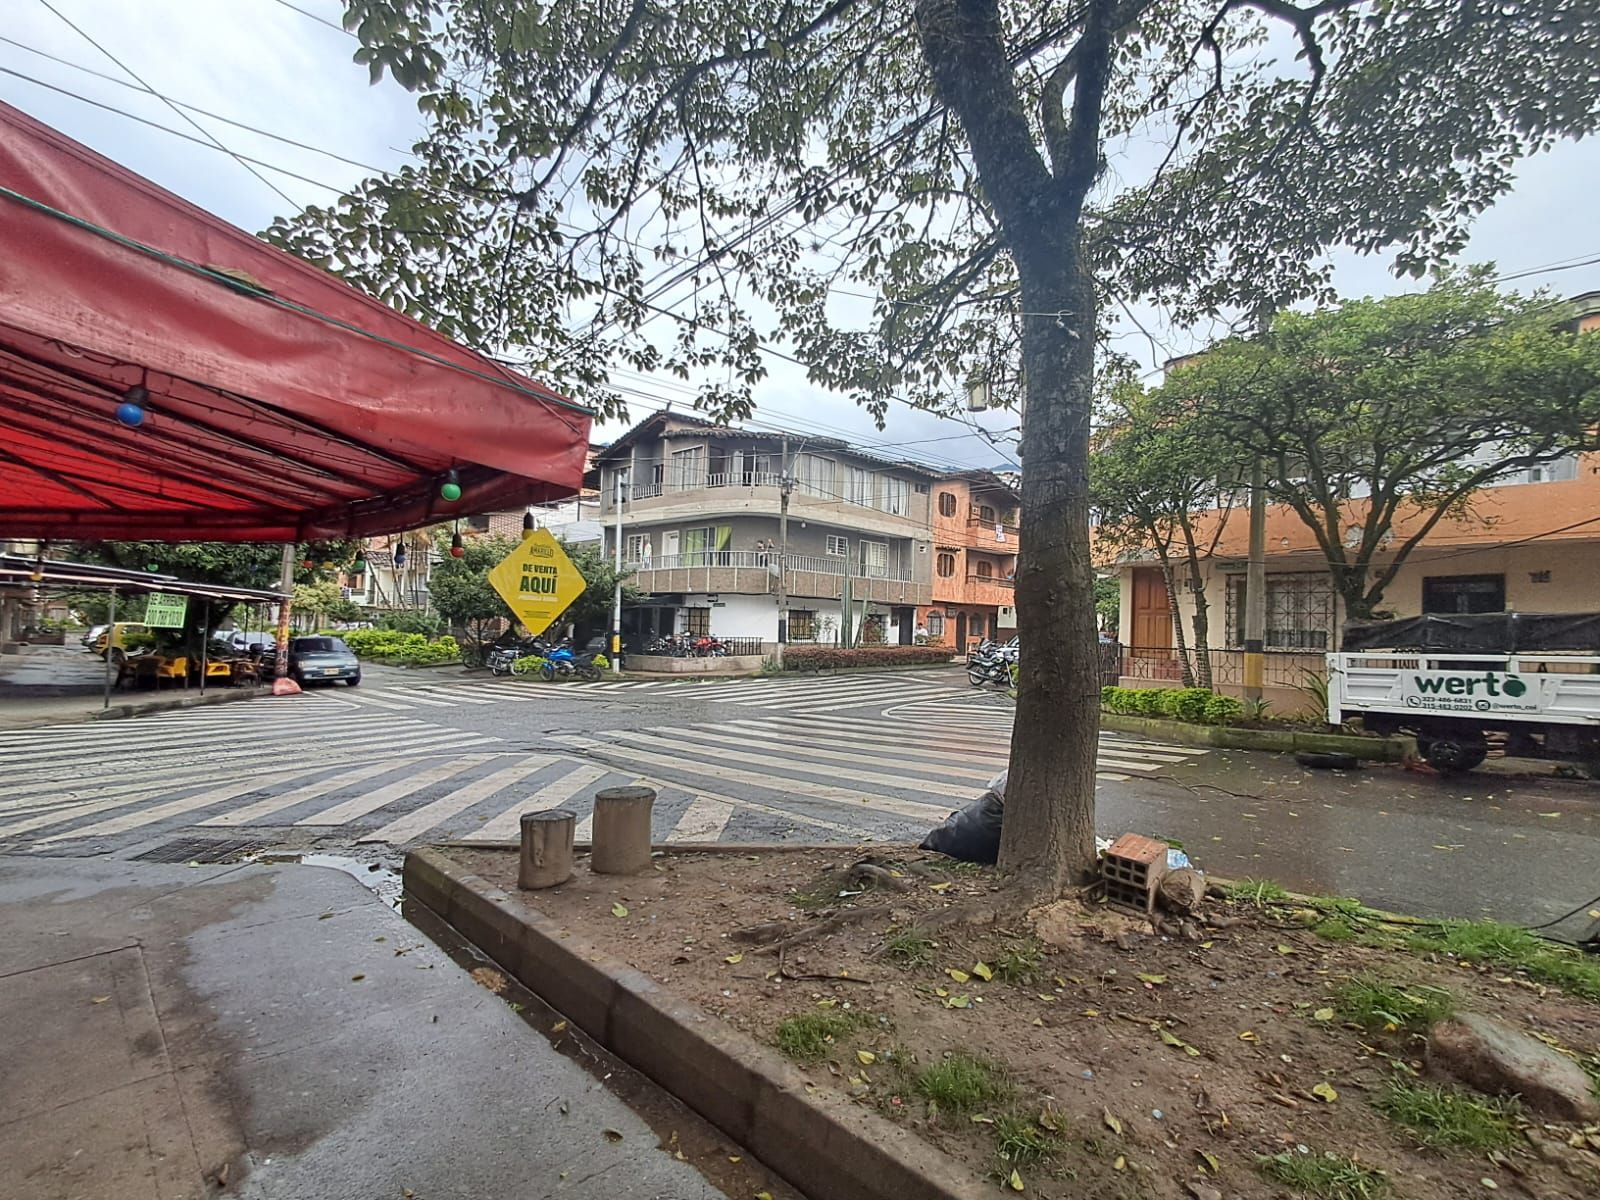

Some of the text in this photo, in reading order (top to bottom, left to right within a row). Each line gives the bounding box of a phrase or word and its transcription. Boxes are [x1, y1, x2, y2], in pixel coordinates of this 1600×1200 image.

[523, 564, 557, 574] DE VENTA
[520, 575, 558, 593] AQUÍ
